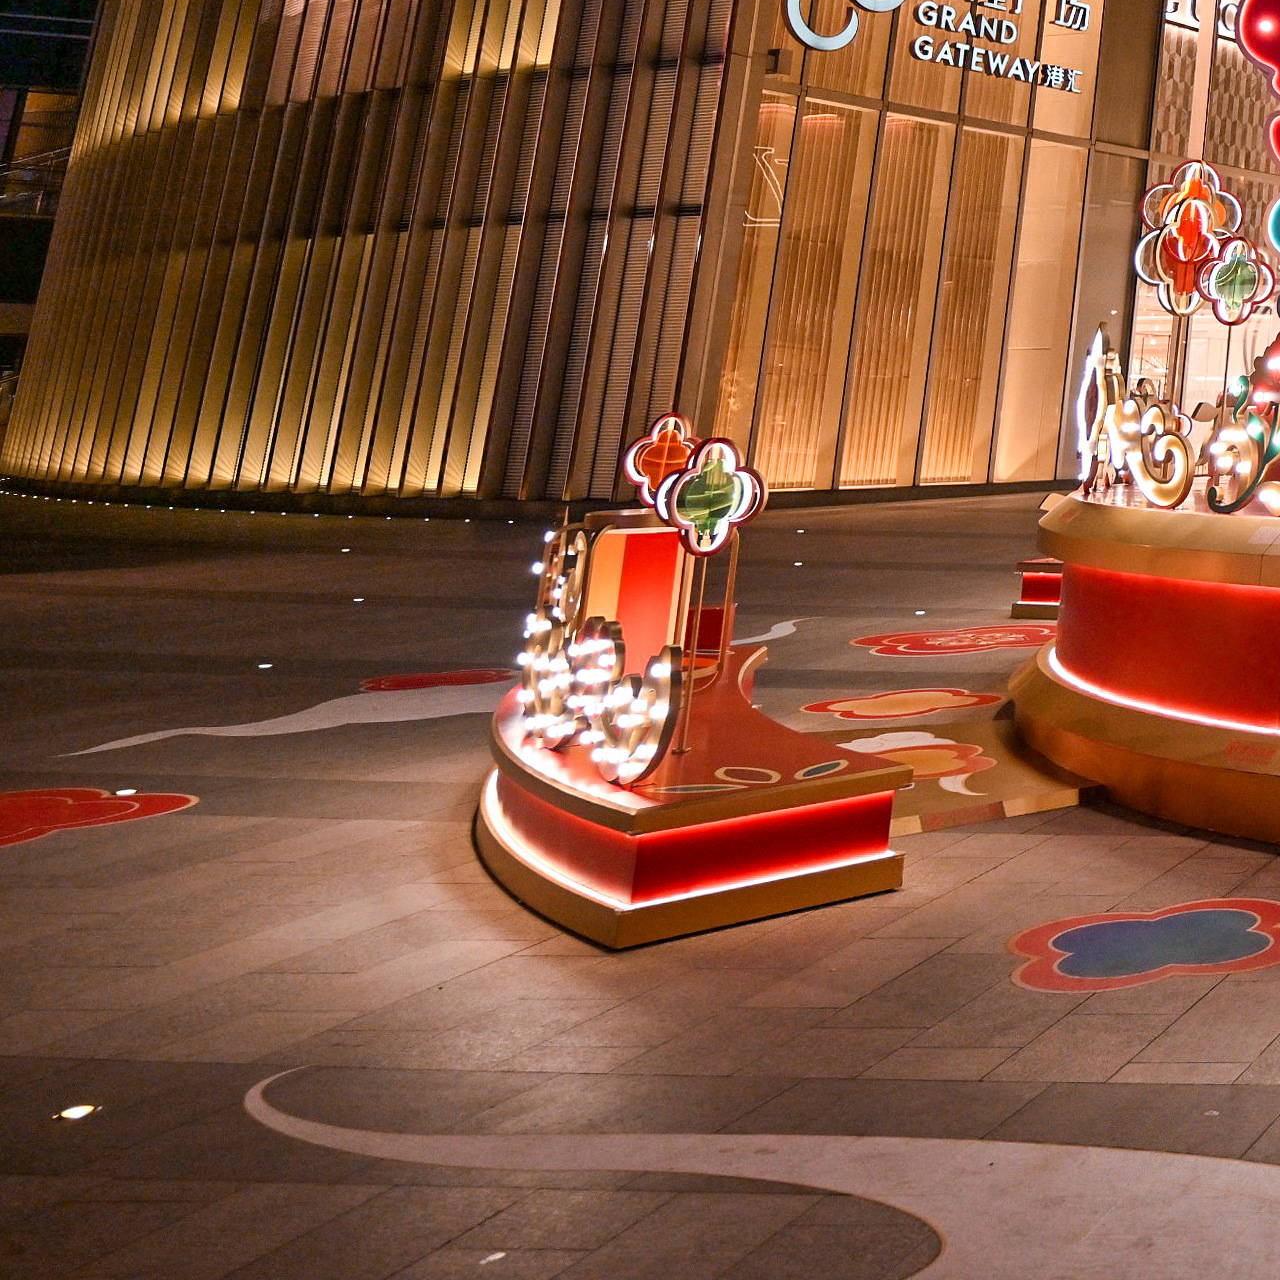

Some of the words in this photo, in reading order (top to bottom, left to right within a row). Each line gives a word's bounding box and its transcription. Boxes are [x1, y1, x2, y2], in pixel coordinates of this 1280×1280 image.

[918, 1, 1018, 44] GRAND
[914, 36, 1040, 83] GATEWAY
[1042, 63, 1083, 94] 港汇
